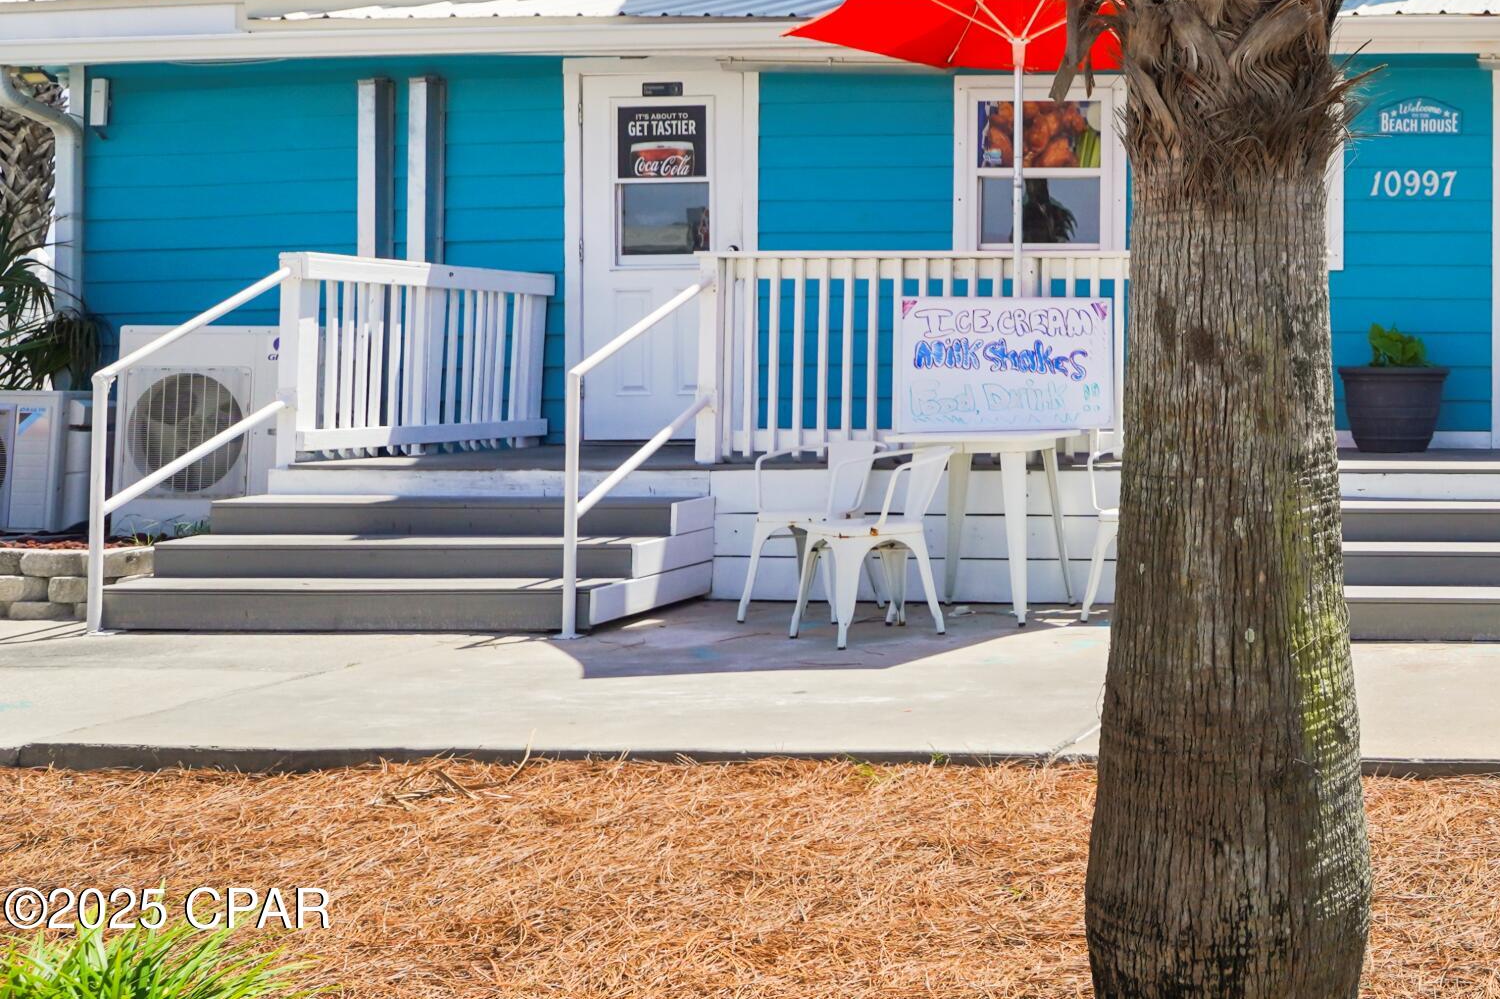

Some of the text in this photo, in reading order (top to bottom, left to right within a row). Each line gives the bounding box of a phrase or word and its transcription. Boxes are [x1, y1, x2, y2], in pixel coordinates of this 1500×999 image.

[651, 112, 676, 120] ABOUT
[1399, 98, 1442, 115] Welcome
[628, 120, 696, 136] GET TASTIER
[1381, 112, 1459, 133] BEACH HOUSE
[634, 154, 691, 176] Coca-Cola
[1370, 170, 1457, 197] 10997
[914, 308, 1094, 338] ICE CREAM
